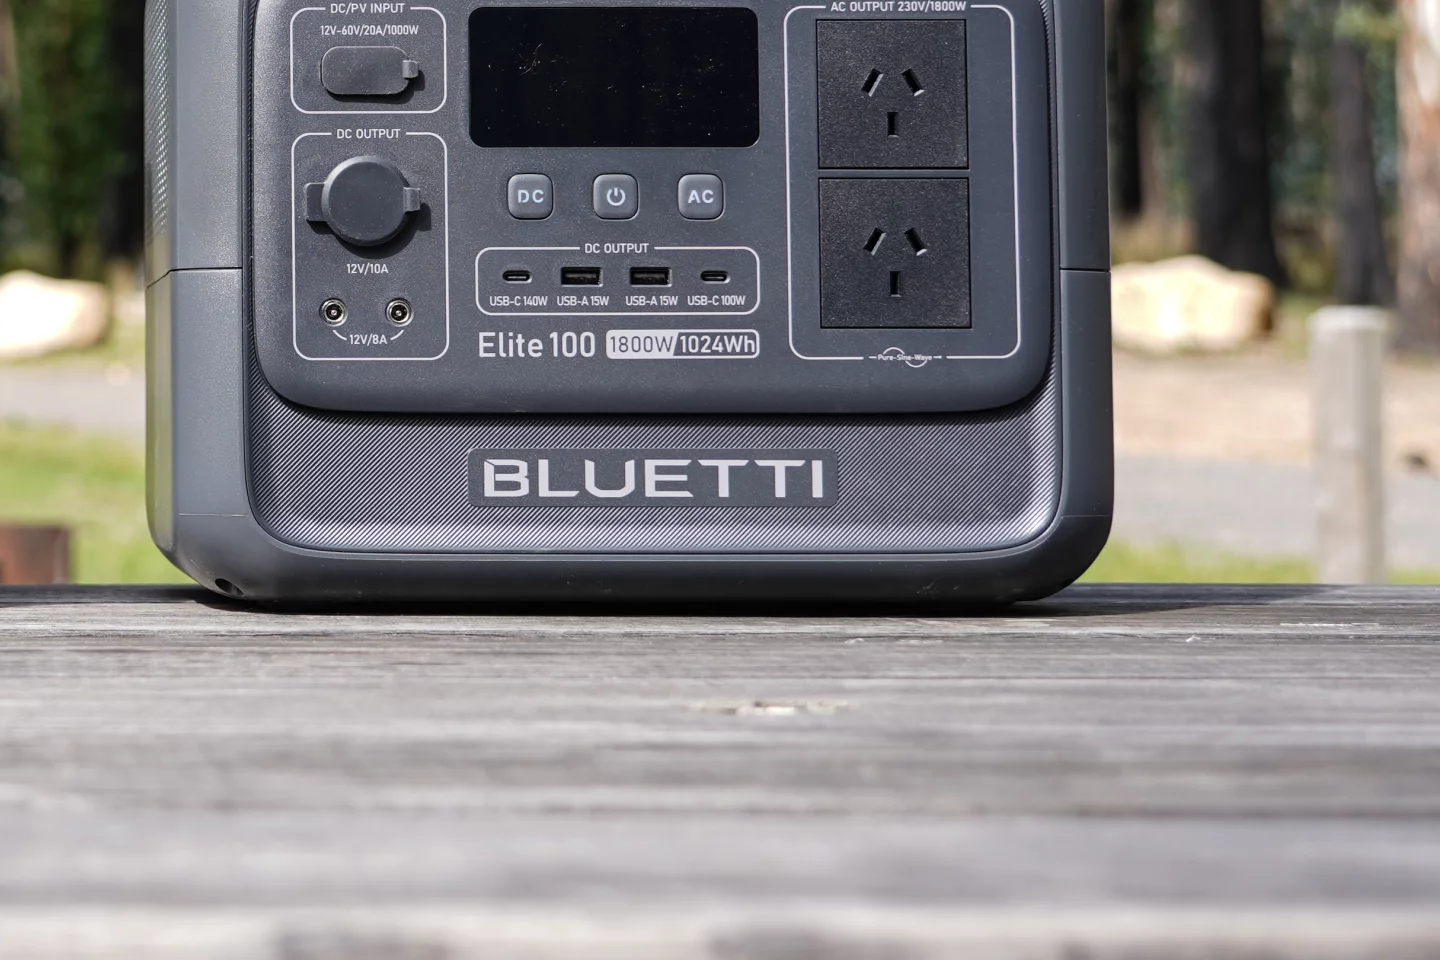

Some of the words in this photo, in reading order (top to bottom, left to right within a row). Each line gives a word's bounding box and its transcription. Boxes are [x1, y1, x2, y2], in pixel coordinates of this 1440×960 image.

[330, 3, 366, 15] DC/PV
[370, 3, 405, 14] INPUT
[831, 2, 845, 11] AC
[849, 2, 894, 12] OUTPUT
[898, 1, 966, 12] 230V/1800W
[320, 24, 419, 36] 12V-60V/20A/1000W
[336, 128, 352, 140] DC
[355, 128, 400, 140] OUTPUT
[518, 190, 544, 204] DC
[688, 190, 714, 204] AC
[584, 243, 600, 254] DC
[604, 243, 649, 254] OUTPUT
[346, 263, 388, 275] 12V/10A
[490, 295, 521, 306] USB-C
[523, 295, 547, 306] 140W
[557, 295, 588, 306] USB-A
[591, 295, 609, 306] 15W
[625, 295, 657, 306] USB-A
[660, 295, 678, 306] 15W
[687, 295, 719, 306] USB-C
[722, 295, 745, 306] 100W
[349, 334, 387, 346] 12V/8A
[479, 332, 542, 358] Elite
[550, 332, 595, 358] 100
[610, 336, 674, 353] 1800W
[483, 459, 823, 498] BLUETTI
